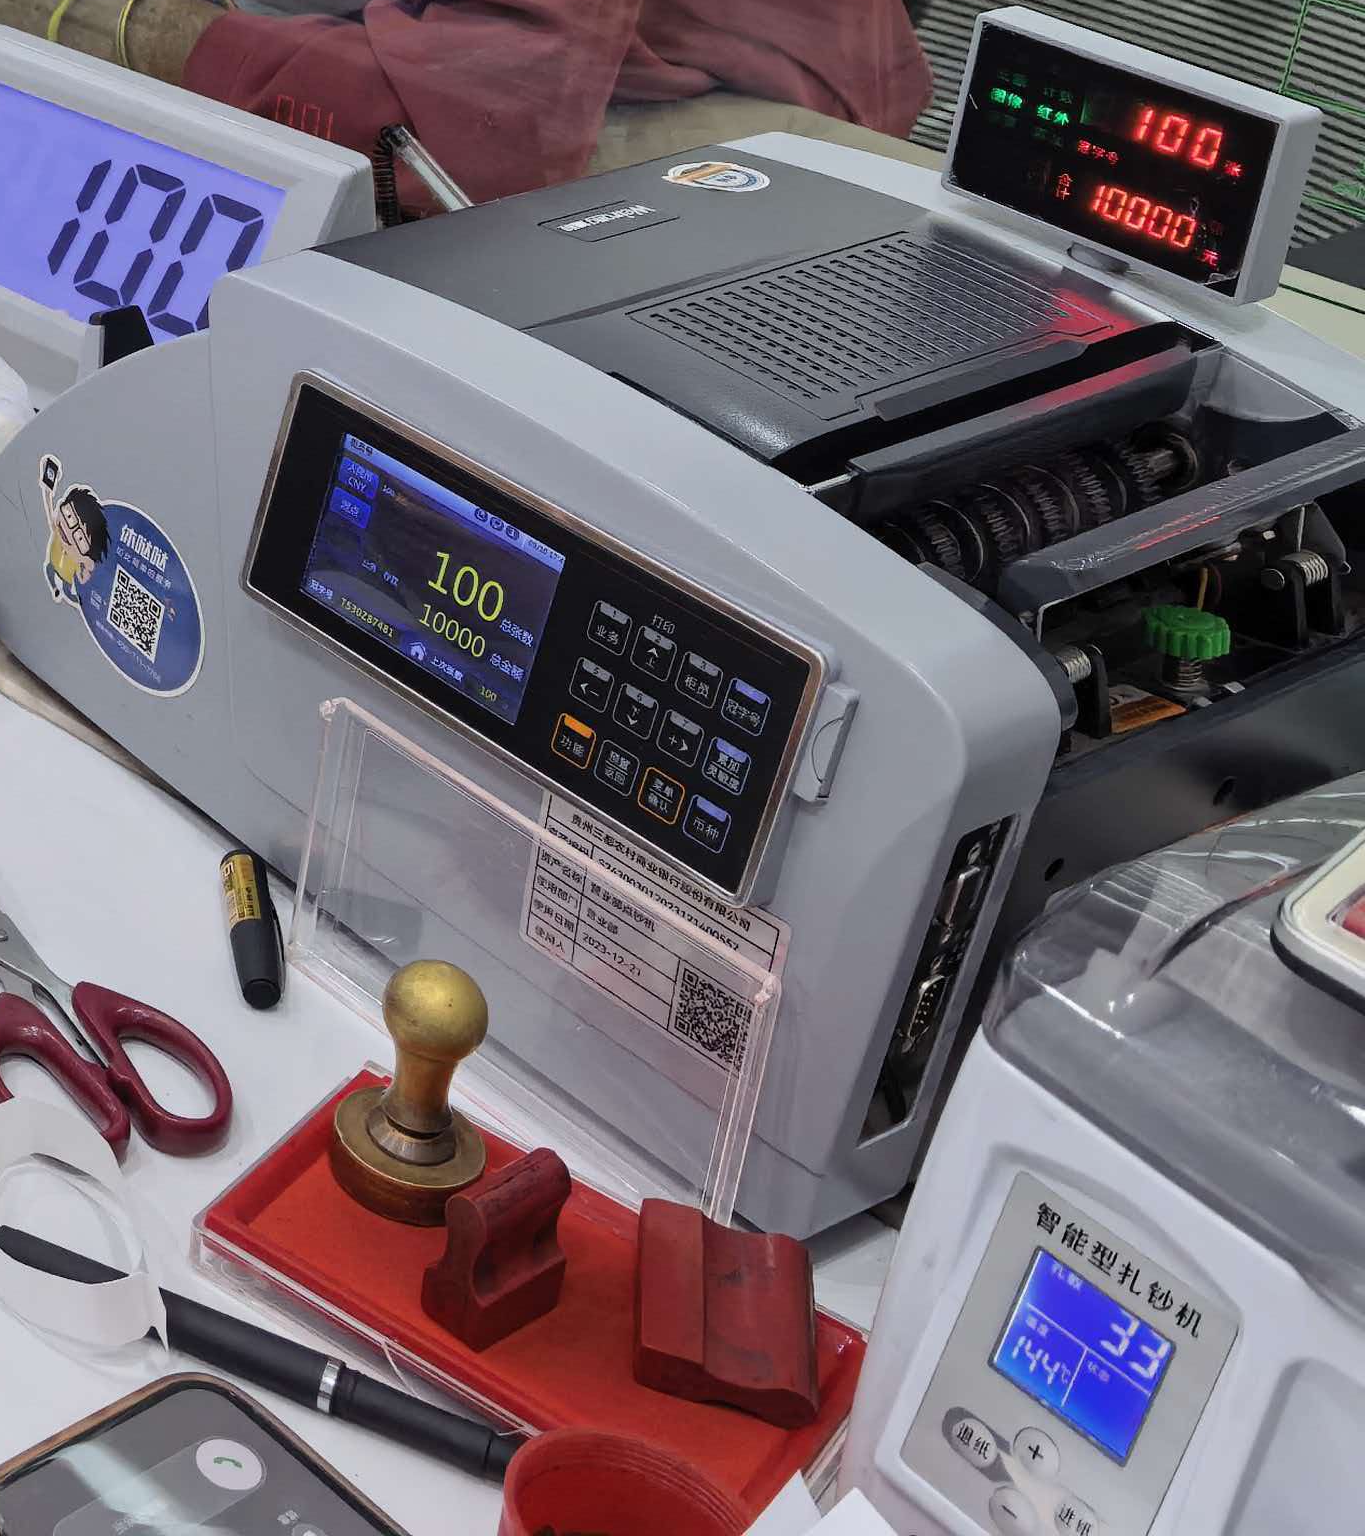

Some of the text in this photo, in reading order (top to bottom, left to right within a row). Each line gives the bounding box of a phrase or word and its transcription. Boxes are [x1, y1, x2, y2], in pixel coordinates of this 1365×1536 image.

[1036, 104, 1070, 126] 红外
[1133, 105, 1222, 167] 100
[1091, 185, 1220, 267] 10000 元
[47, 159, 265, 338] 100
[427, 551, 505, 622] 100
[500, 618, 534, 649] 总张数
[419, 603, 486, 658] 10000
[596, 625, 620, 646] 业务
[652, 614, 676, 634] 打印
[684, 676, 709, 698] 柜员
[727, 699, 761, 728] 冠字号
[560, 735, 585, 757] 功能
[693, 816, 719, 841] 币种
[1036, 1202, 1202, 1338] 智能型扎钞机
[1100, 1316, 1170, 1379] 33
[956, 1422, 990, 1460] 退纸
